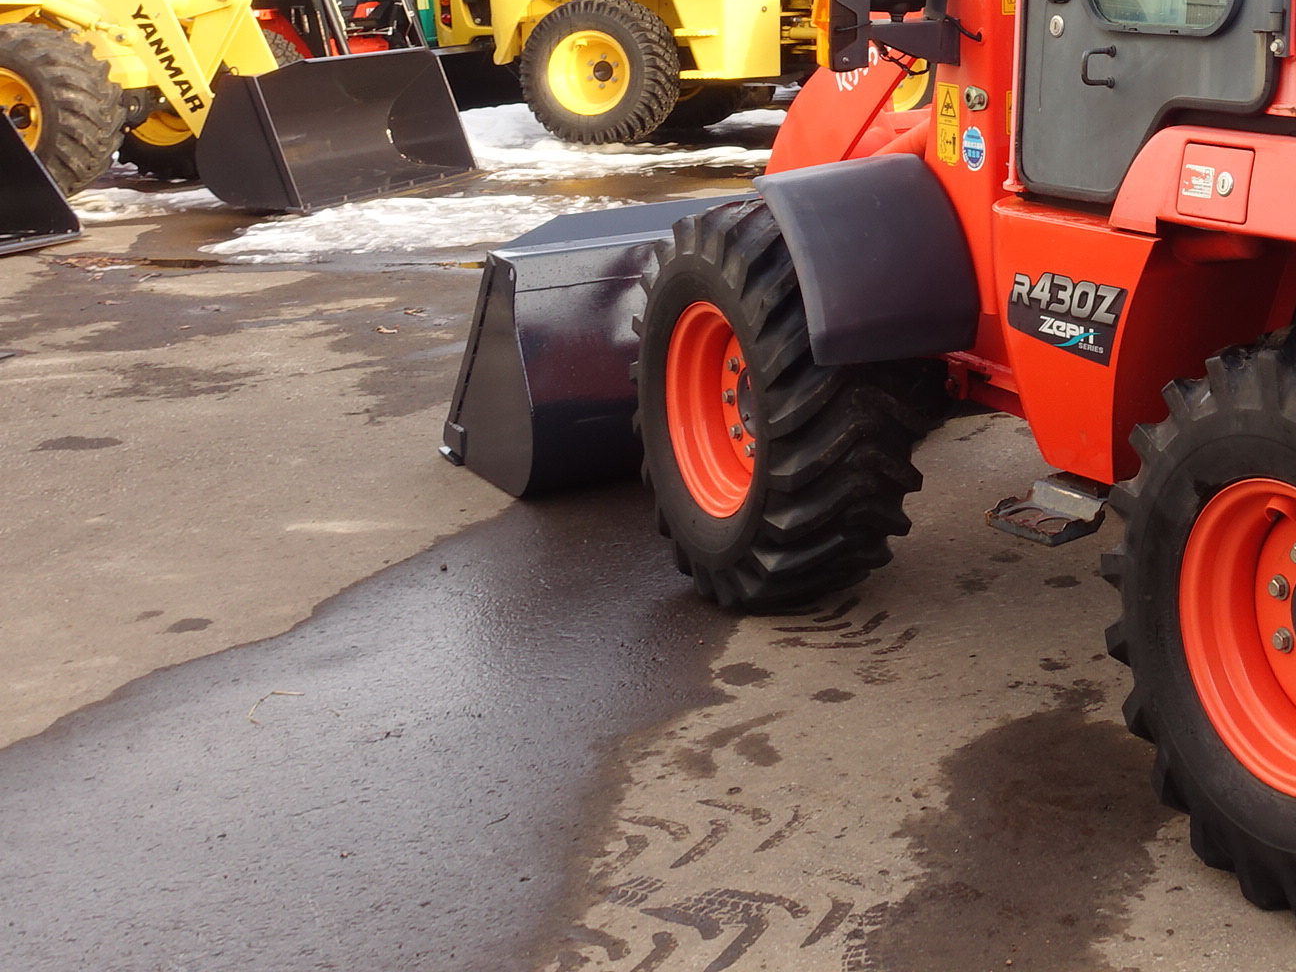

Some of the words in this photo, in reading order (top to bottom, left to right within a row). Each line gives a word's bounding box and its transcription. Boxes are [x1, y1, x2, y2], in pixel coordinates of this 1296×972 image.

[131, 3, 205, 114] YANMAR
[1011, 271, 1121, 326] R430Z
[1078, 341, 1104, 354] SERIES
